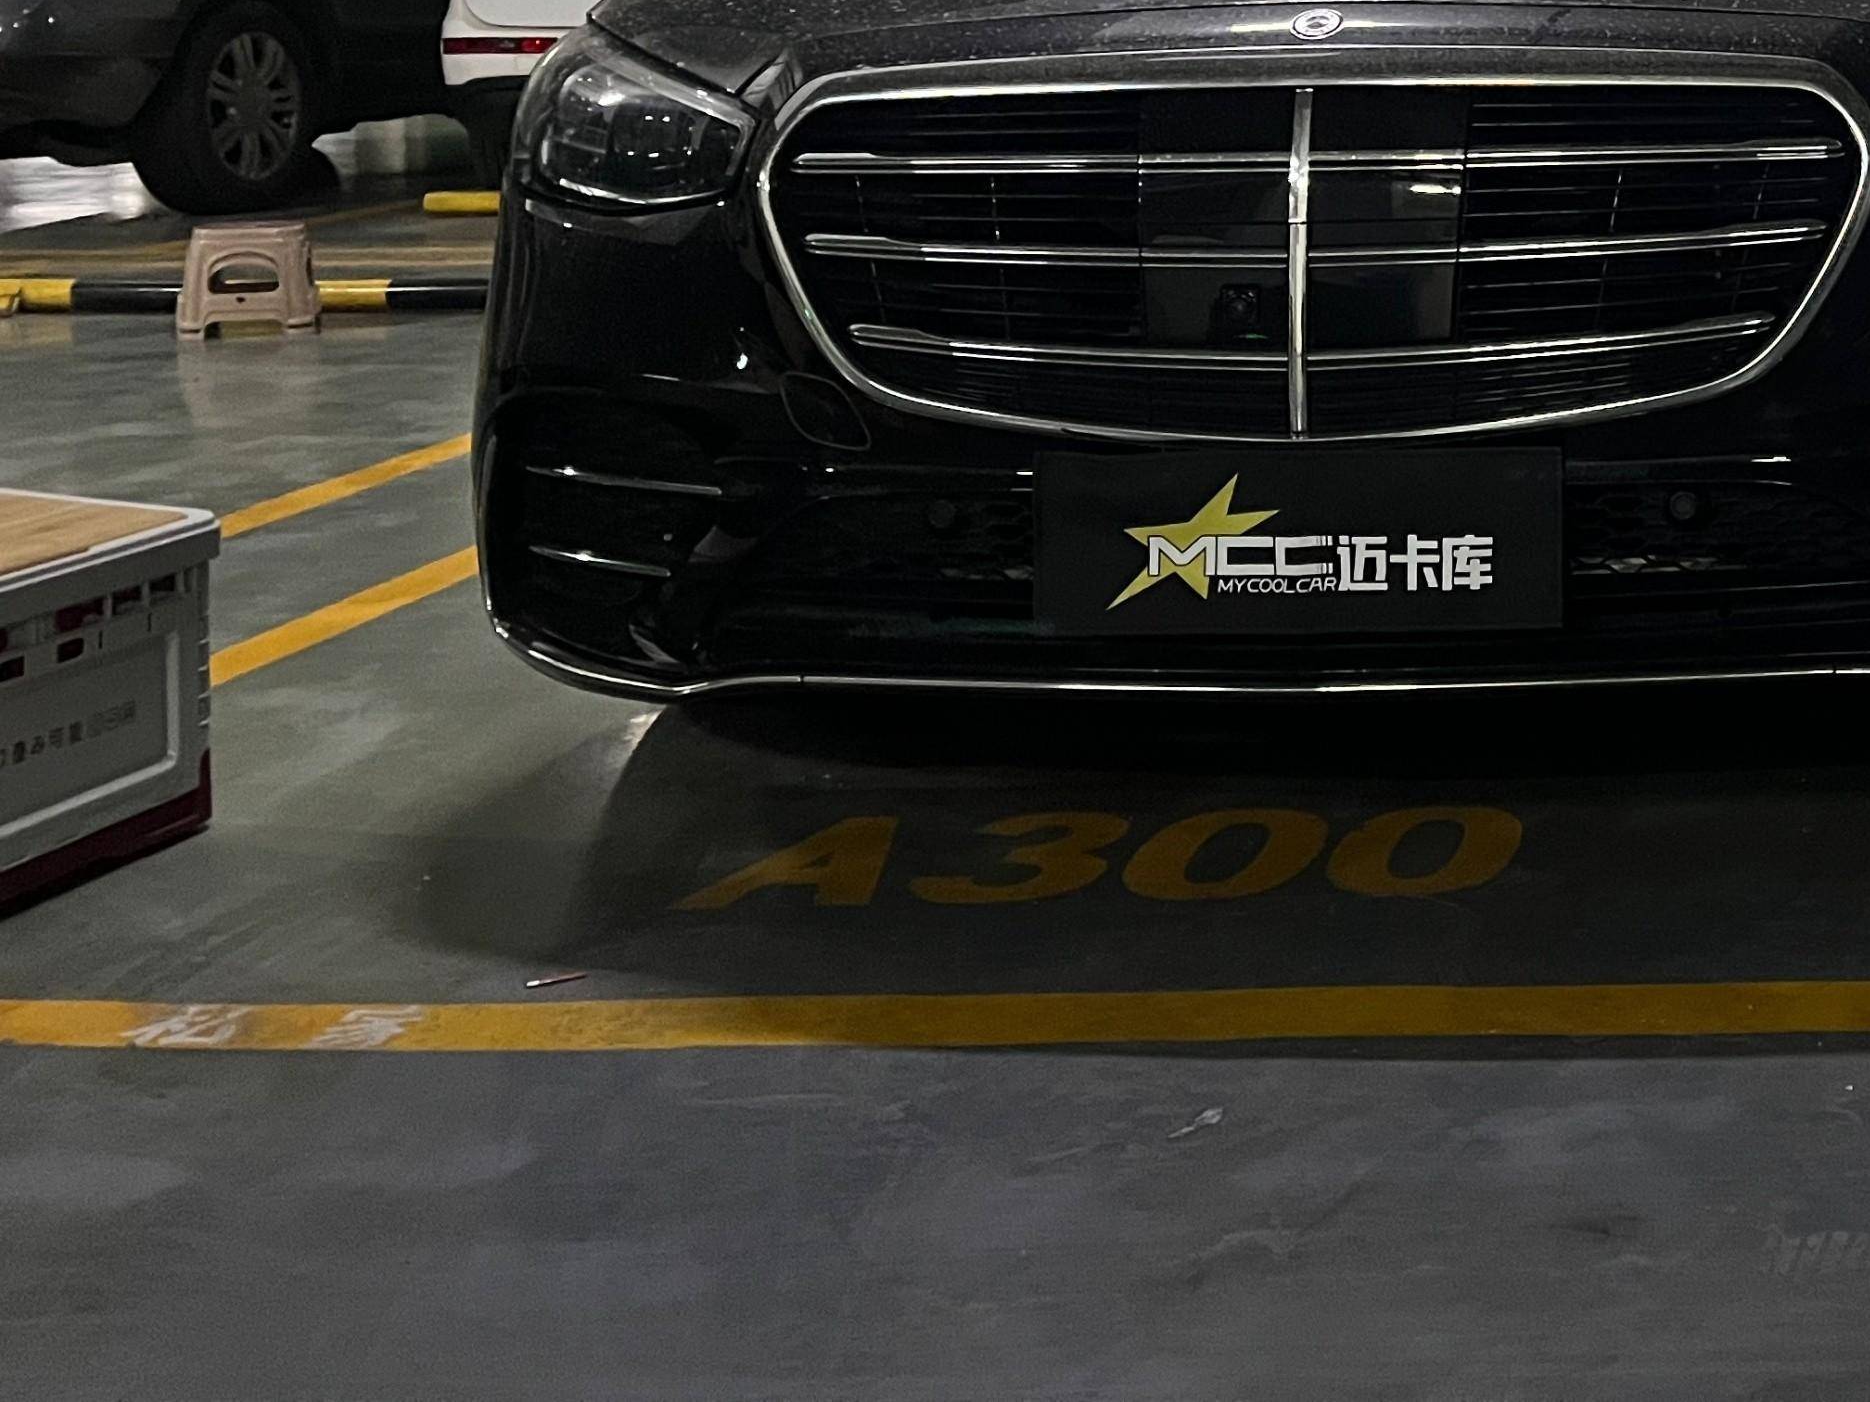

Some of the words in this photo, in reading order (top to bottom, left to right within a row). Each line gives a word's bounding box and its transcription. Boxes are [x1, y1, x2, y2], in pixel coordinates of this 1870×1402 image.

[1149, 535, 1335, 577] MCC
[1336, 534, 1494, 592] 迈卡库
[666, 805, 1523, 910] A300
